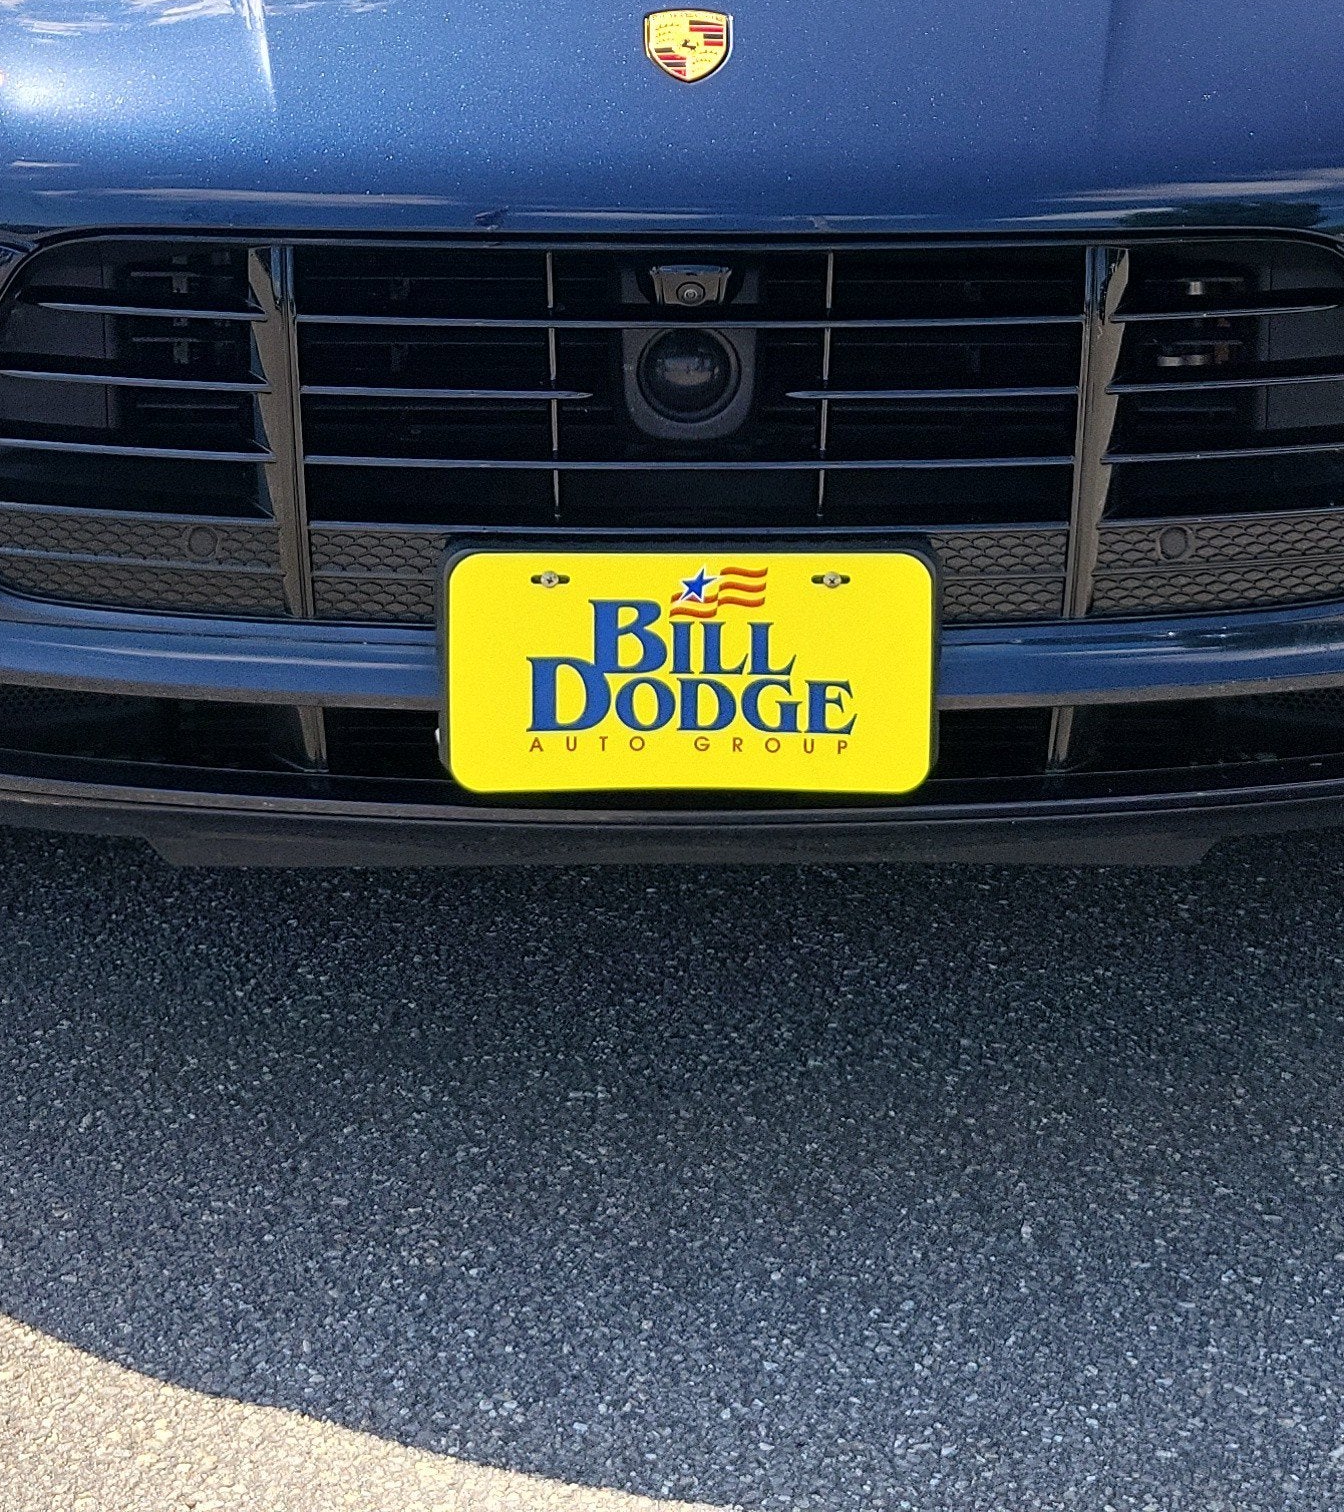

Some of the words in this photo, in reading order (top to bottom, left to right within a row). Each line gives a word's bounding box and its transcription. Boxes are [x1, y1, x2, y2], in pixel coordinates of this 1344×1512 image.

[588, 598, 797, 675] BILL
[526, 656, 858, 734] DODGE
[529, 735, 646, 753] AUTO
[693, 735, 848, 755] GROUP
